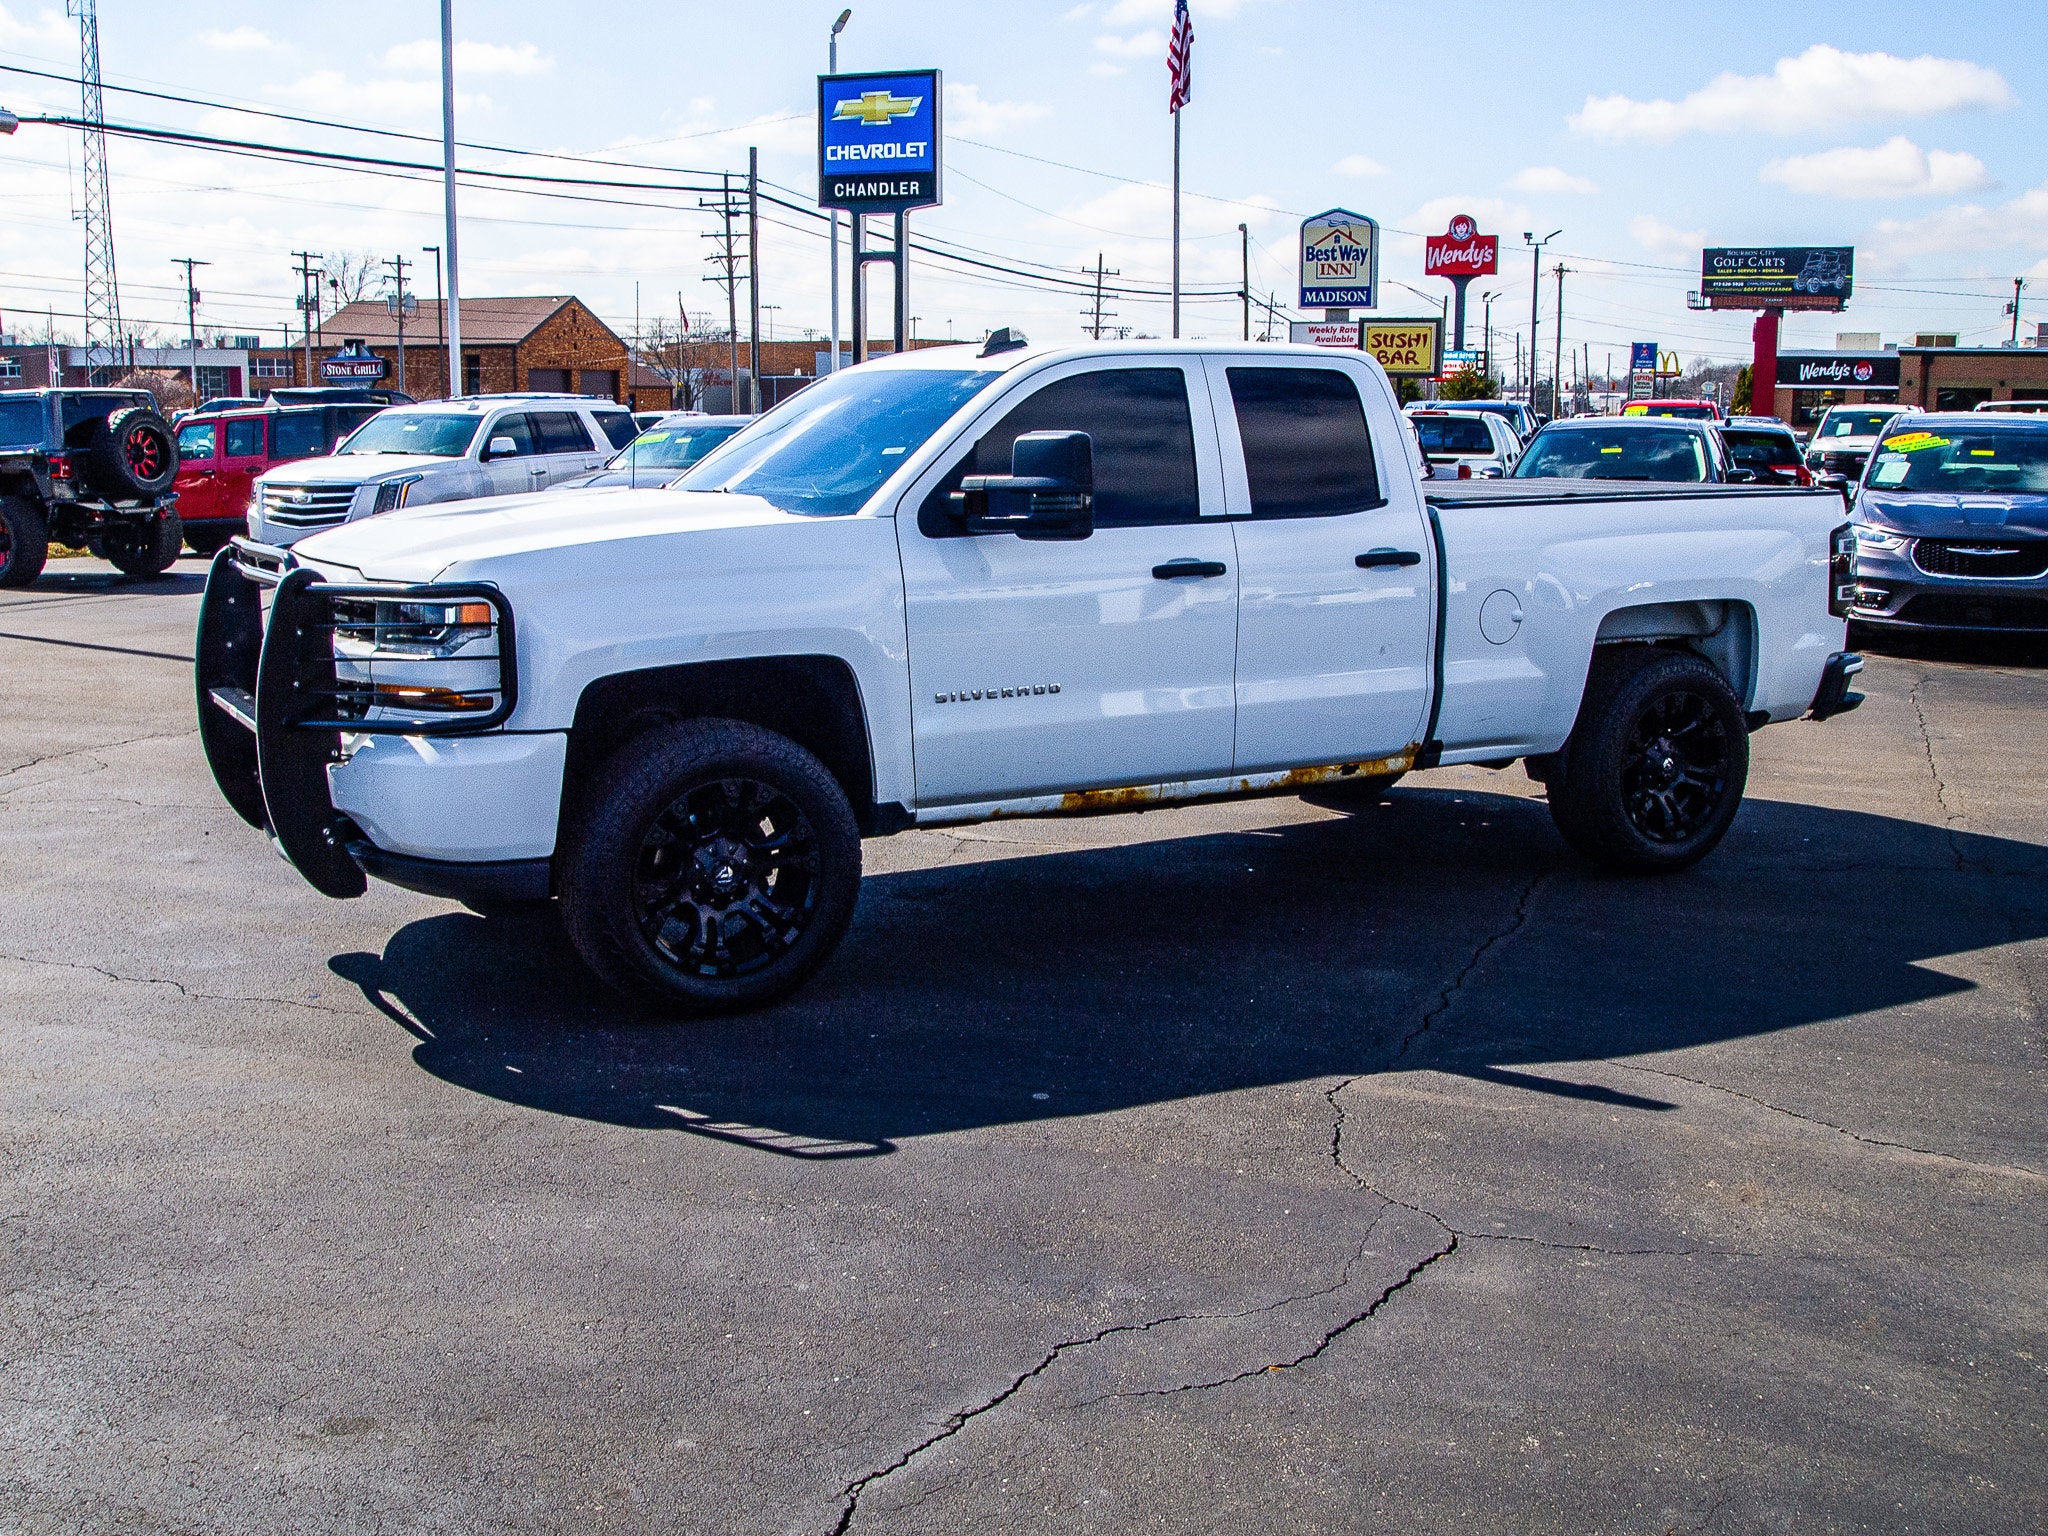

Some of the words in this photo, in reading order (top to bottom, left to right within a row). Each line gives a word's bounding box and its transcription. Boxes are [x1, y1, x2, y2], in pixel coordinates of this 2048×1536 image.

[826, 142, 928, 161] CHEVROLET
[834, 181, 920, 197] CHANDLER
[1306, 246, 1337, 262] Best
[1339, 245, 1369, 266] Way
[1427, 240, 1494, 270] Wendy's
[1713, 257, 1744, 267] GOLF
[1748, 257, 1786, 267] CARTS
[1319, 263, 1353, 275] INN
[1304, 291, 1367, 303] MADISON
[1308, 326, 1337, 334] Weekly
[1339, 326, 1358, 334] Rate
[1315, 335, 1354, 343] Available
[1370, 332, 1428, 349] SUSHI
[1376, 350, 1419, 365] BAR
[326, 364, 352, 376] STONE
[354, 364, 377, 375] GRILL
[1800, 360, 1850, 381] Wendy's
[935, 682, 1061, 704] SILVERADO
